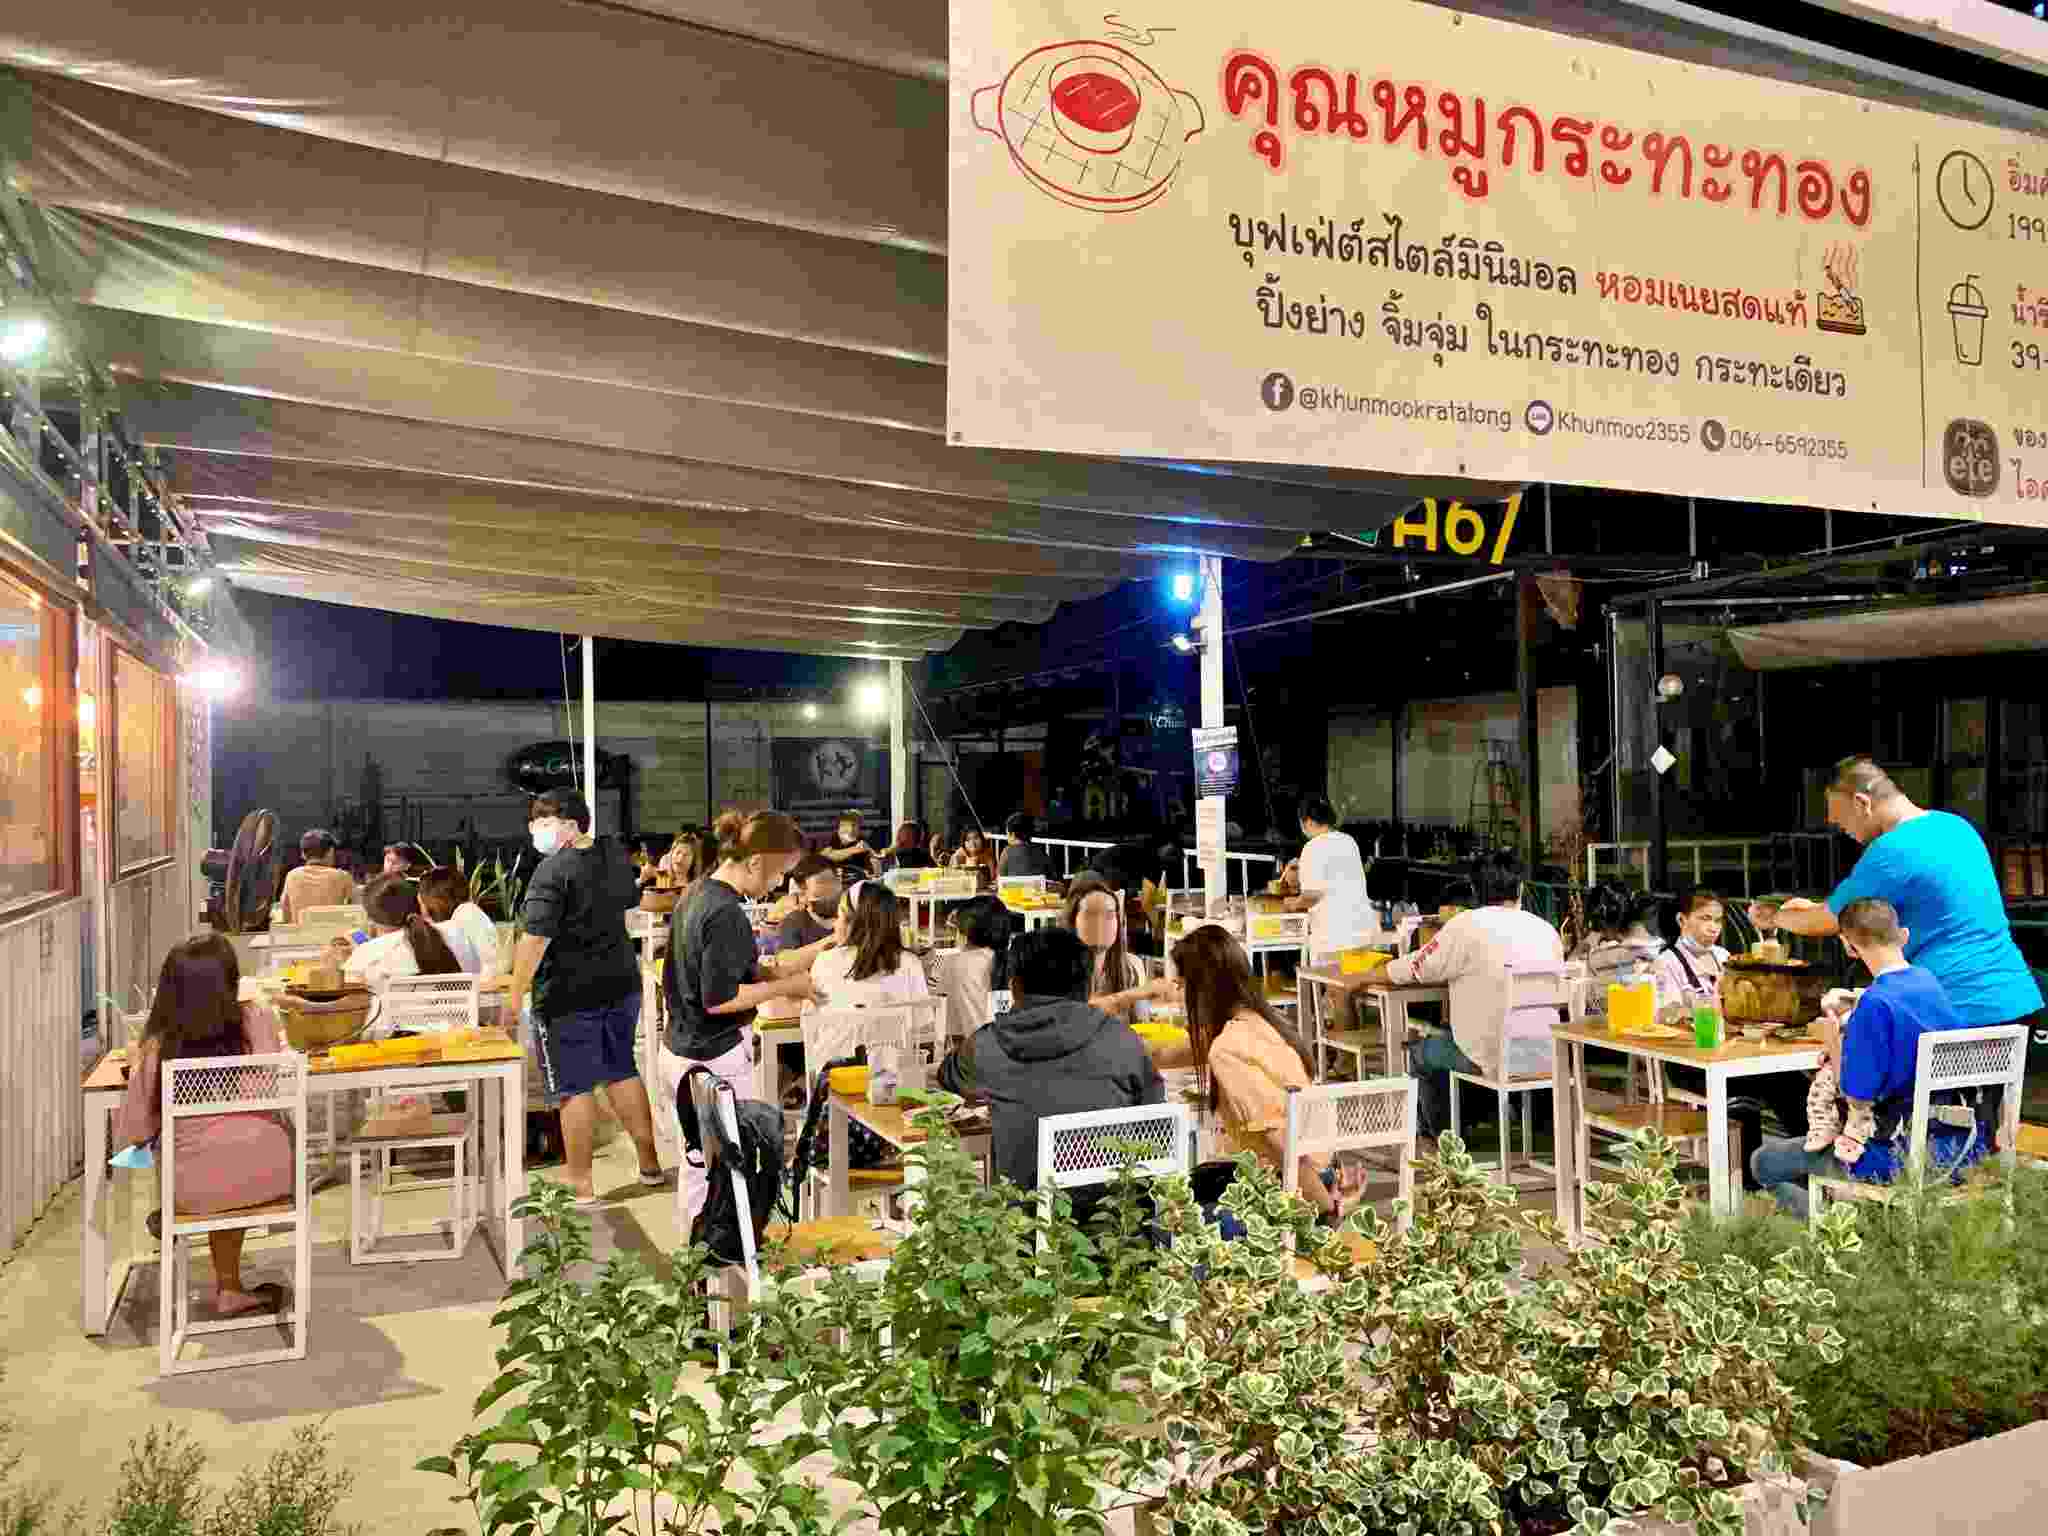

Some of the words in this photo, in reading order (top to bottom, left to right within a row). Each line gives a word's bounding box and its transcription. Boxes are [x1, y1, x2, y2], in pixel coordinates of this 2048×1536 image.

[1224, 54, 1872, 226] คุณหมูกระทะทอง
[1228, 212, 1577, 296] บุฟเฟ่ต์สไตล์มินิมอล
[1595, 270, 1808, 328] หอมเนยสดแท้
[1256, 272, 1365, 339] ปิ้งย่าง
[1381, 288, 1468, 368] จิ้มจุ่ม
[1475, 302, 1681, 377] ในกระทะทอง
[1695, 354, 1848, 398] กระทะเดียว
[1299, 386, 1512, 432] @khunmookratatong
[1557, 411, 1691, 443] Khunmoo2355
[1730, 429, 1849, 460] 064-6592355
